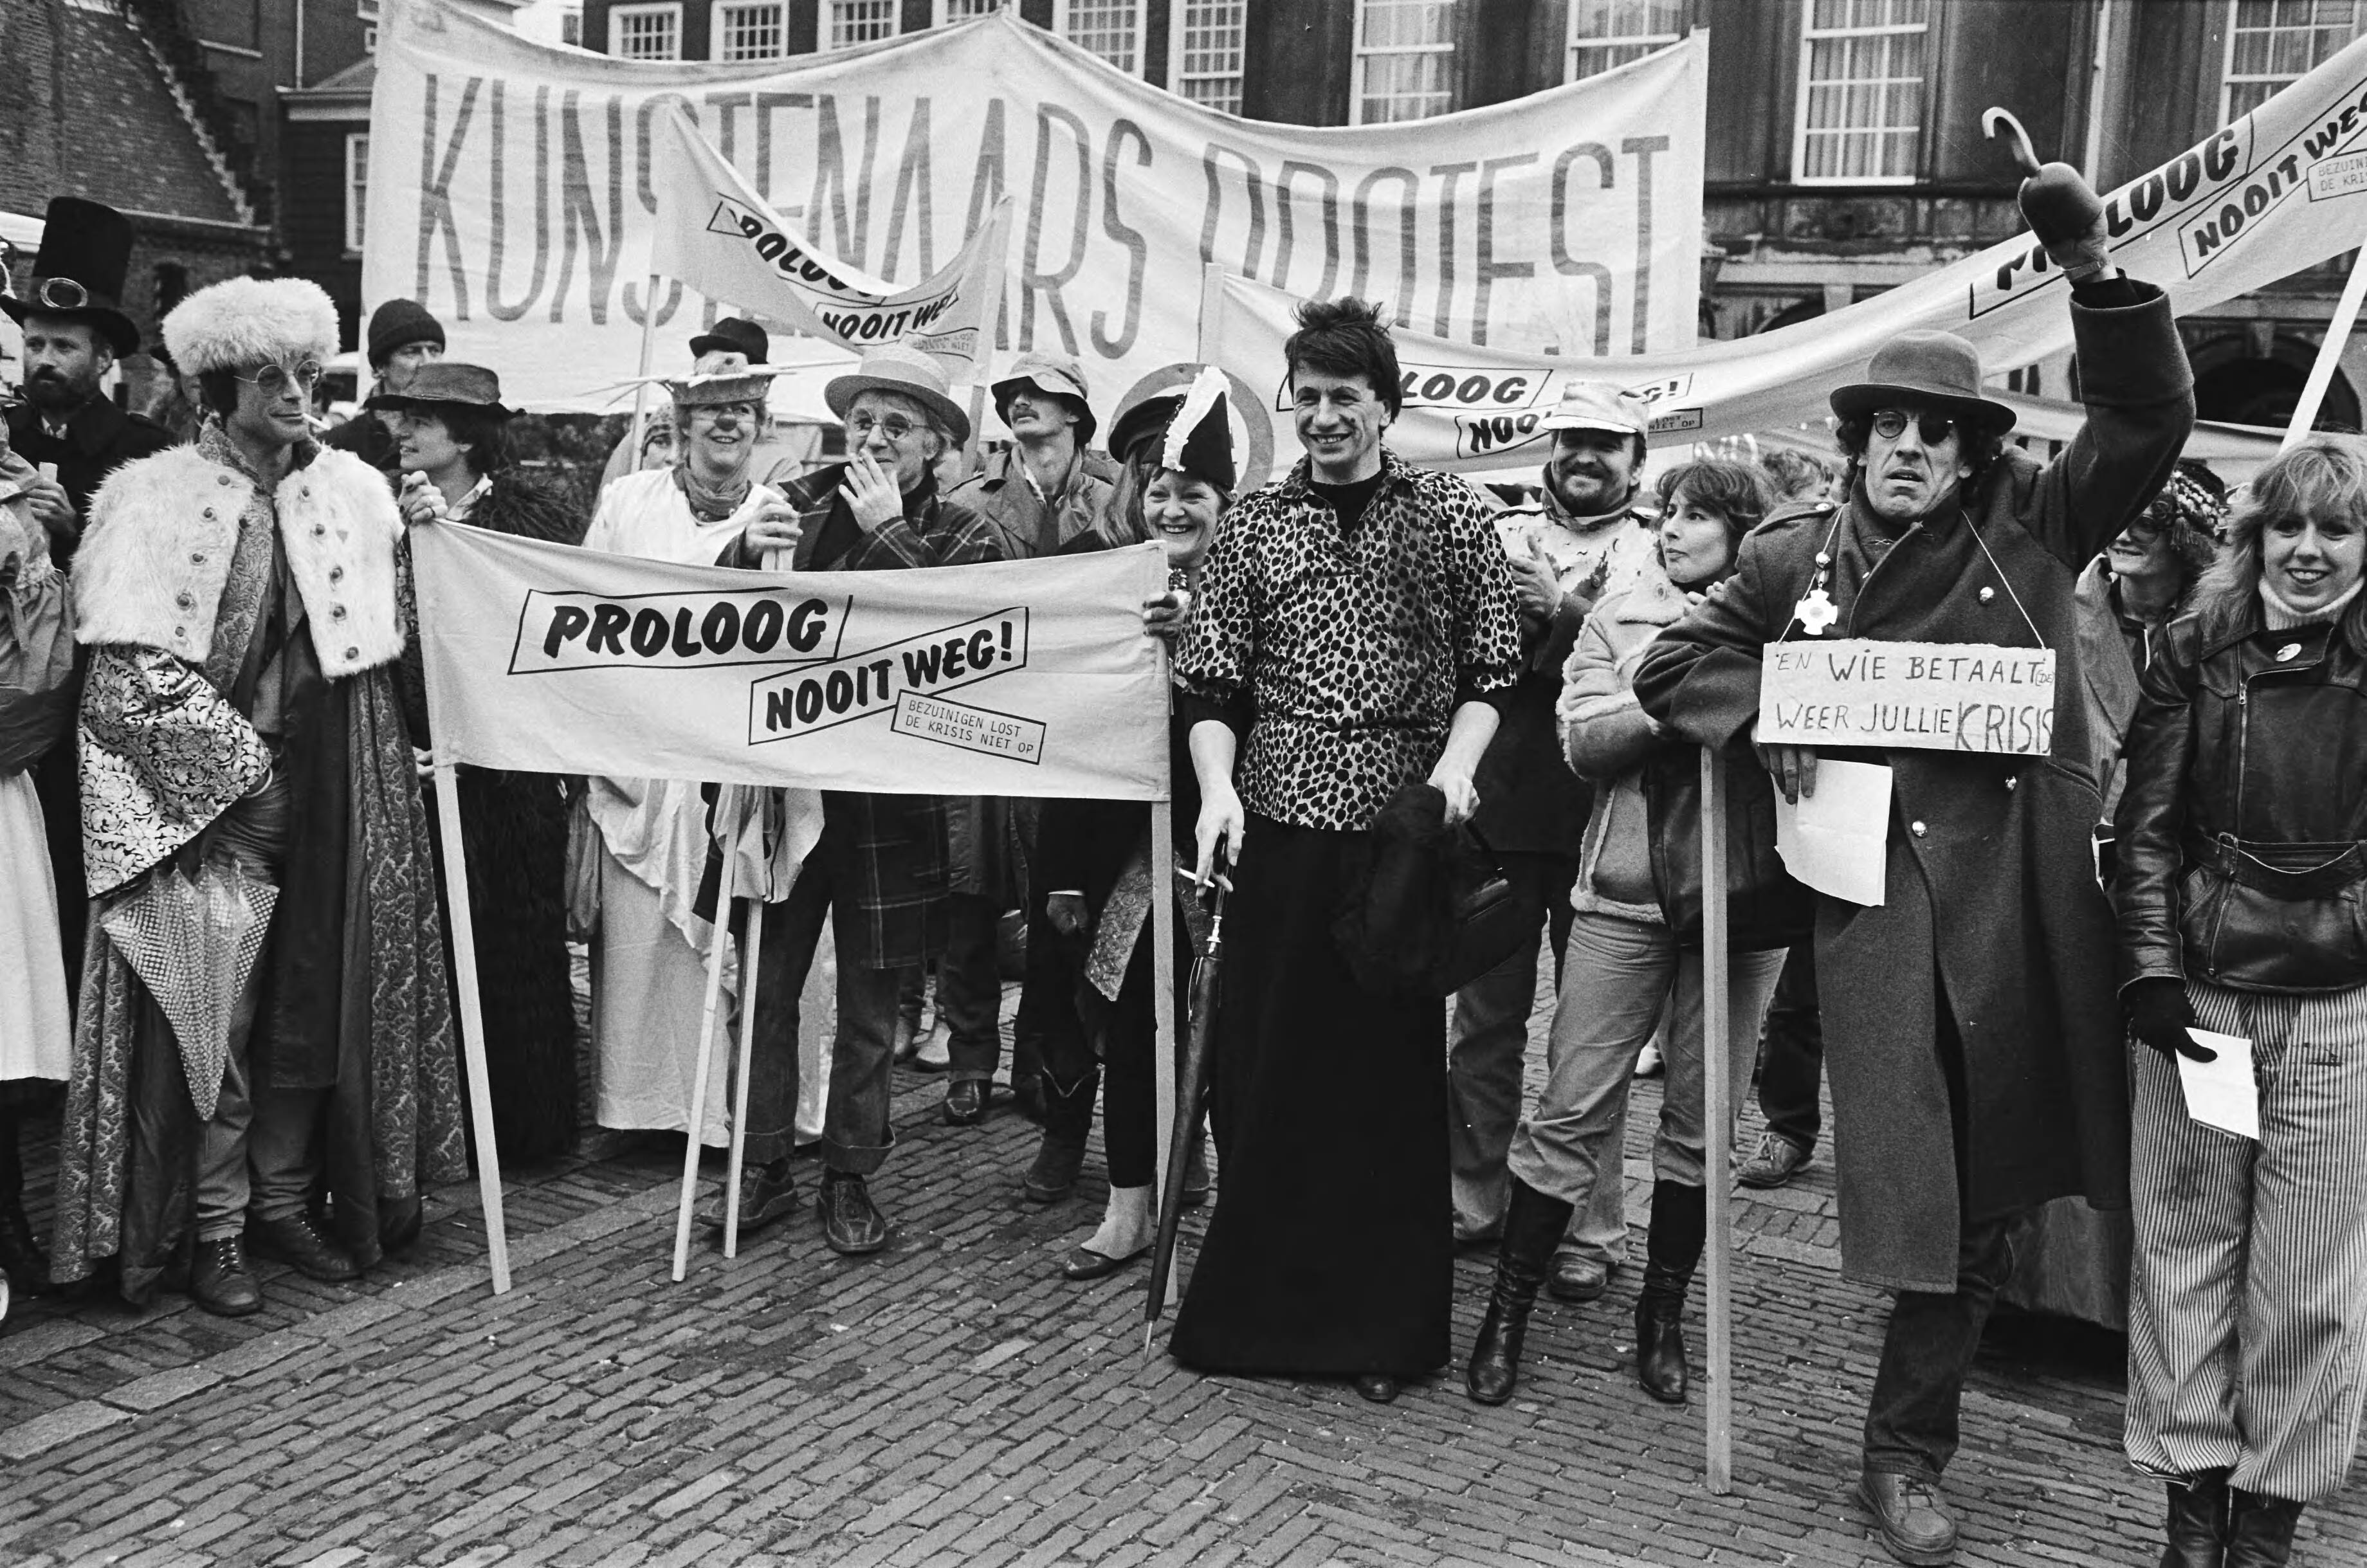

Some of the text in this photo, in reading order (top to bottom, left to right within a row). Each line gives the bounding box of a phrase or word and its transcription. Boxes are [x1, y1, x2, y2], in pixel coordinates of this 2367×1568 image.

[2194, 154, 2299, 257] NOOIT
[2320, 172, 2367, 191] DE KRI
[543, 598, 828, 659] PROLOOG
[765, 619, 1014, 732] NOOIT WEG!
[906, 715, 1034, 754] DE KRISIS NIET OP
[908, 700, 1022, 738] BEZUINIGEN LOST
[1777, 702, 1849, 730] WEER
[1955, 700, 2054, 754] KRISIS
